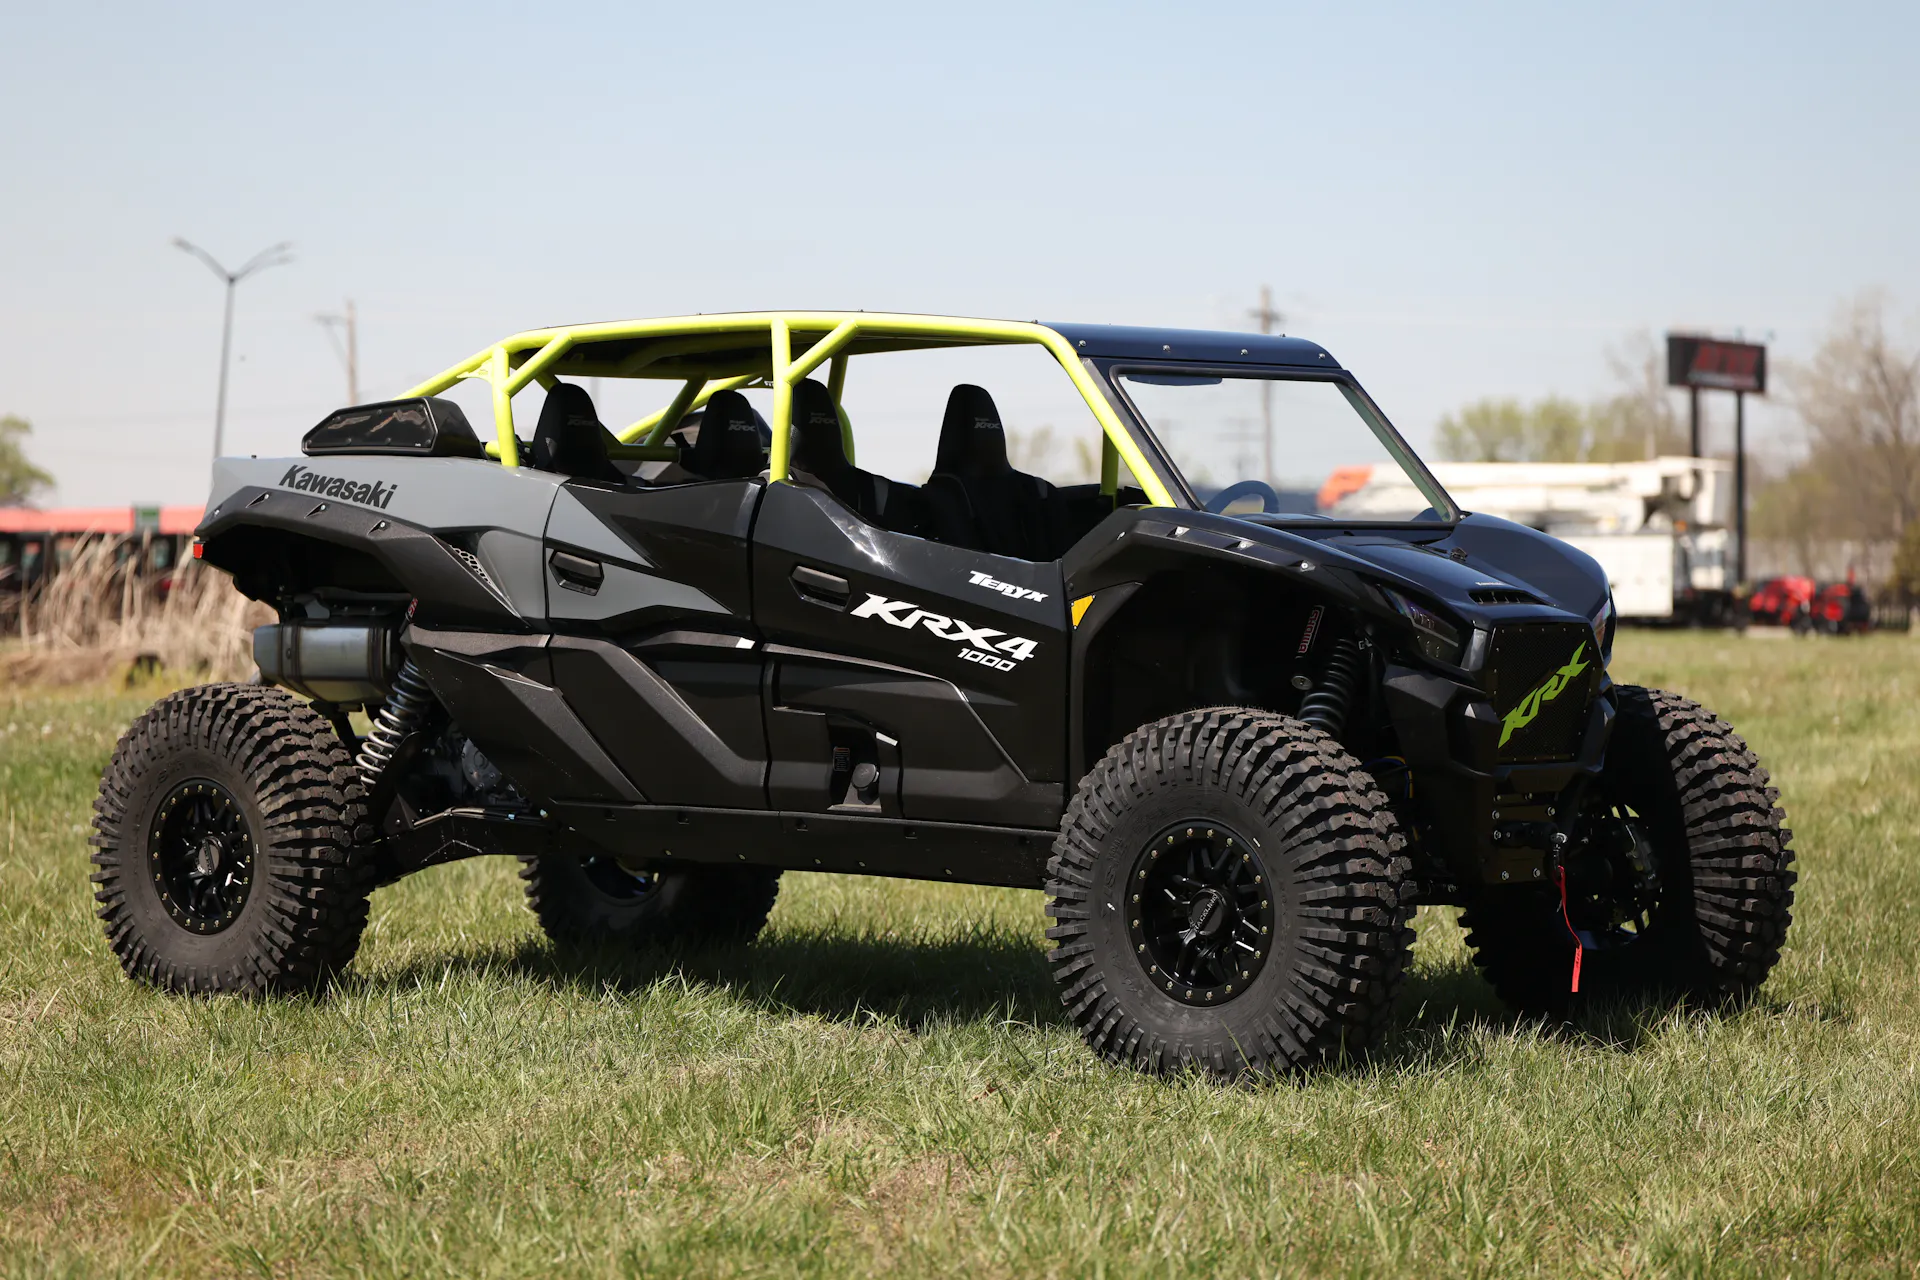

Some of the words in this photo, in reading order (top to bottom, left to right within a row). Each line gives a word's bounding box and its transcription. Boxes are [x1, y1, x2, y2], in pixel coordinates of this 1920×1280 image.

[279, 464, 398, 509] Kawasaki
[957, 647, 1017, 672] 1000
[1498, 640, 1590, 749] KRX
